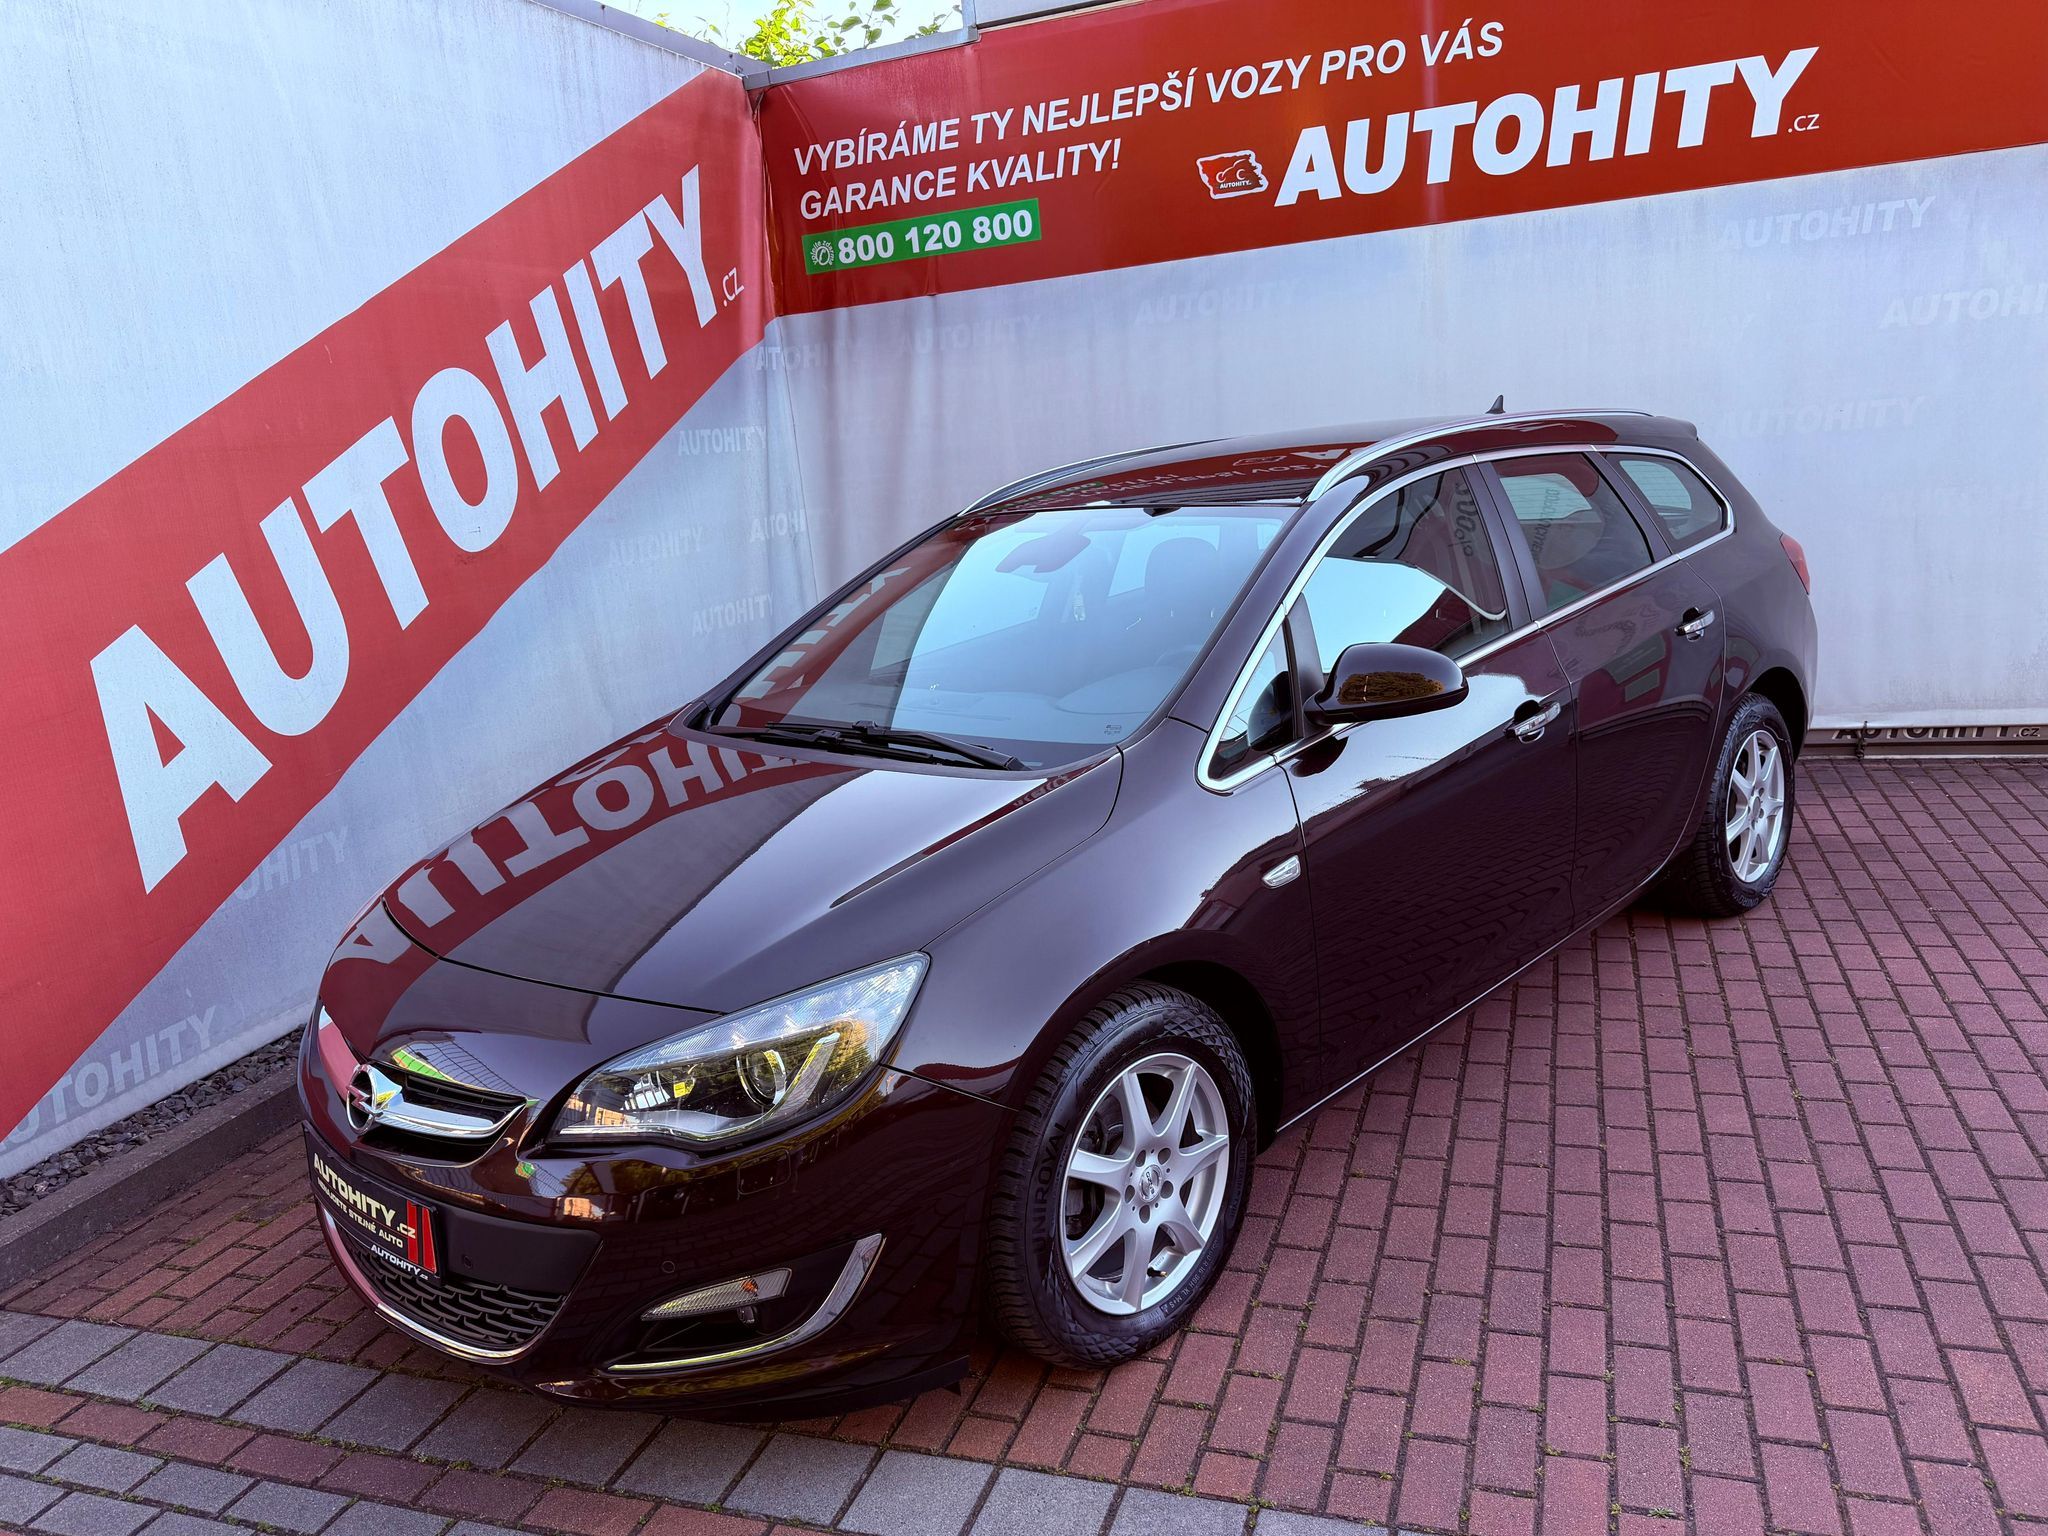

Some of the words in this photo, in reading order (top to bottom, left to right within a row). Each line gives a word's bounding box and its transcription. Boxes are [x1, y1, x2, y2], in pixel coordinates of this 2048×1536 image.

[795, 120, 960, 175] VYBÍRÁME
[971, 107, 1013, 143] TY
[1023, 68, 1198, 135] NEJLEPŠÍ
[1206, 55, 1312, 102] VOZY
[1320, 40, 1406, 84] PRO
[1421, 18, 1504, 66] VÁS
[1274, 46, 1819, 207] AUTOHITY
[800, 166, 957, 220] GARANCE
[967, 138, 1121, 193] KVALITY!
[838, 231, 895, 264] 800
[905, 221, 962, 254] 120
[973, 210, 1033, 244] 800
[90, 164, 718, 895] AUTOHITY
[313, 1152, 396, 1227] AUTOHITY
[349, 1209, 377, 1234] STEJNÉ
[379, 1229, 404, 1249] AUTO
[370, 1244, 421, 1276] AUTOHITY
